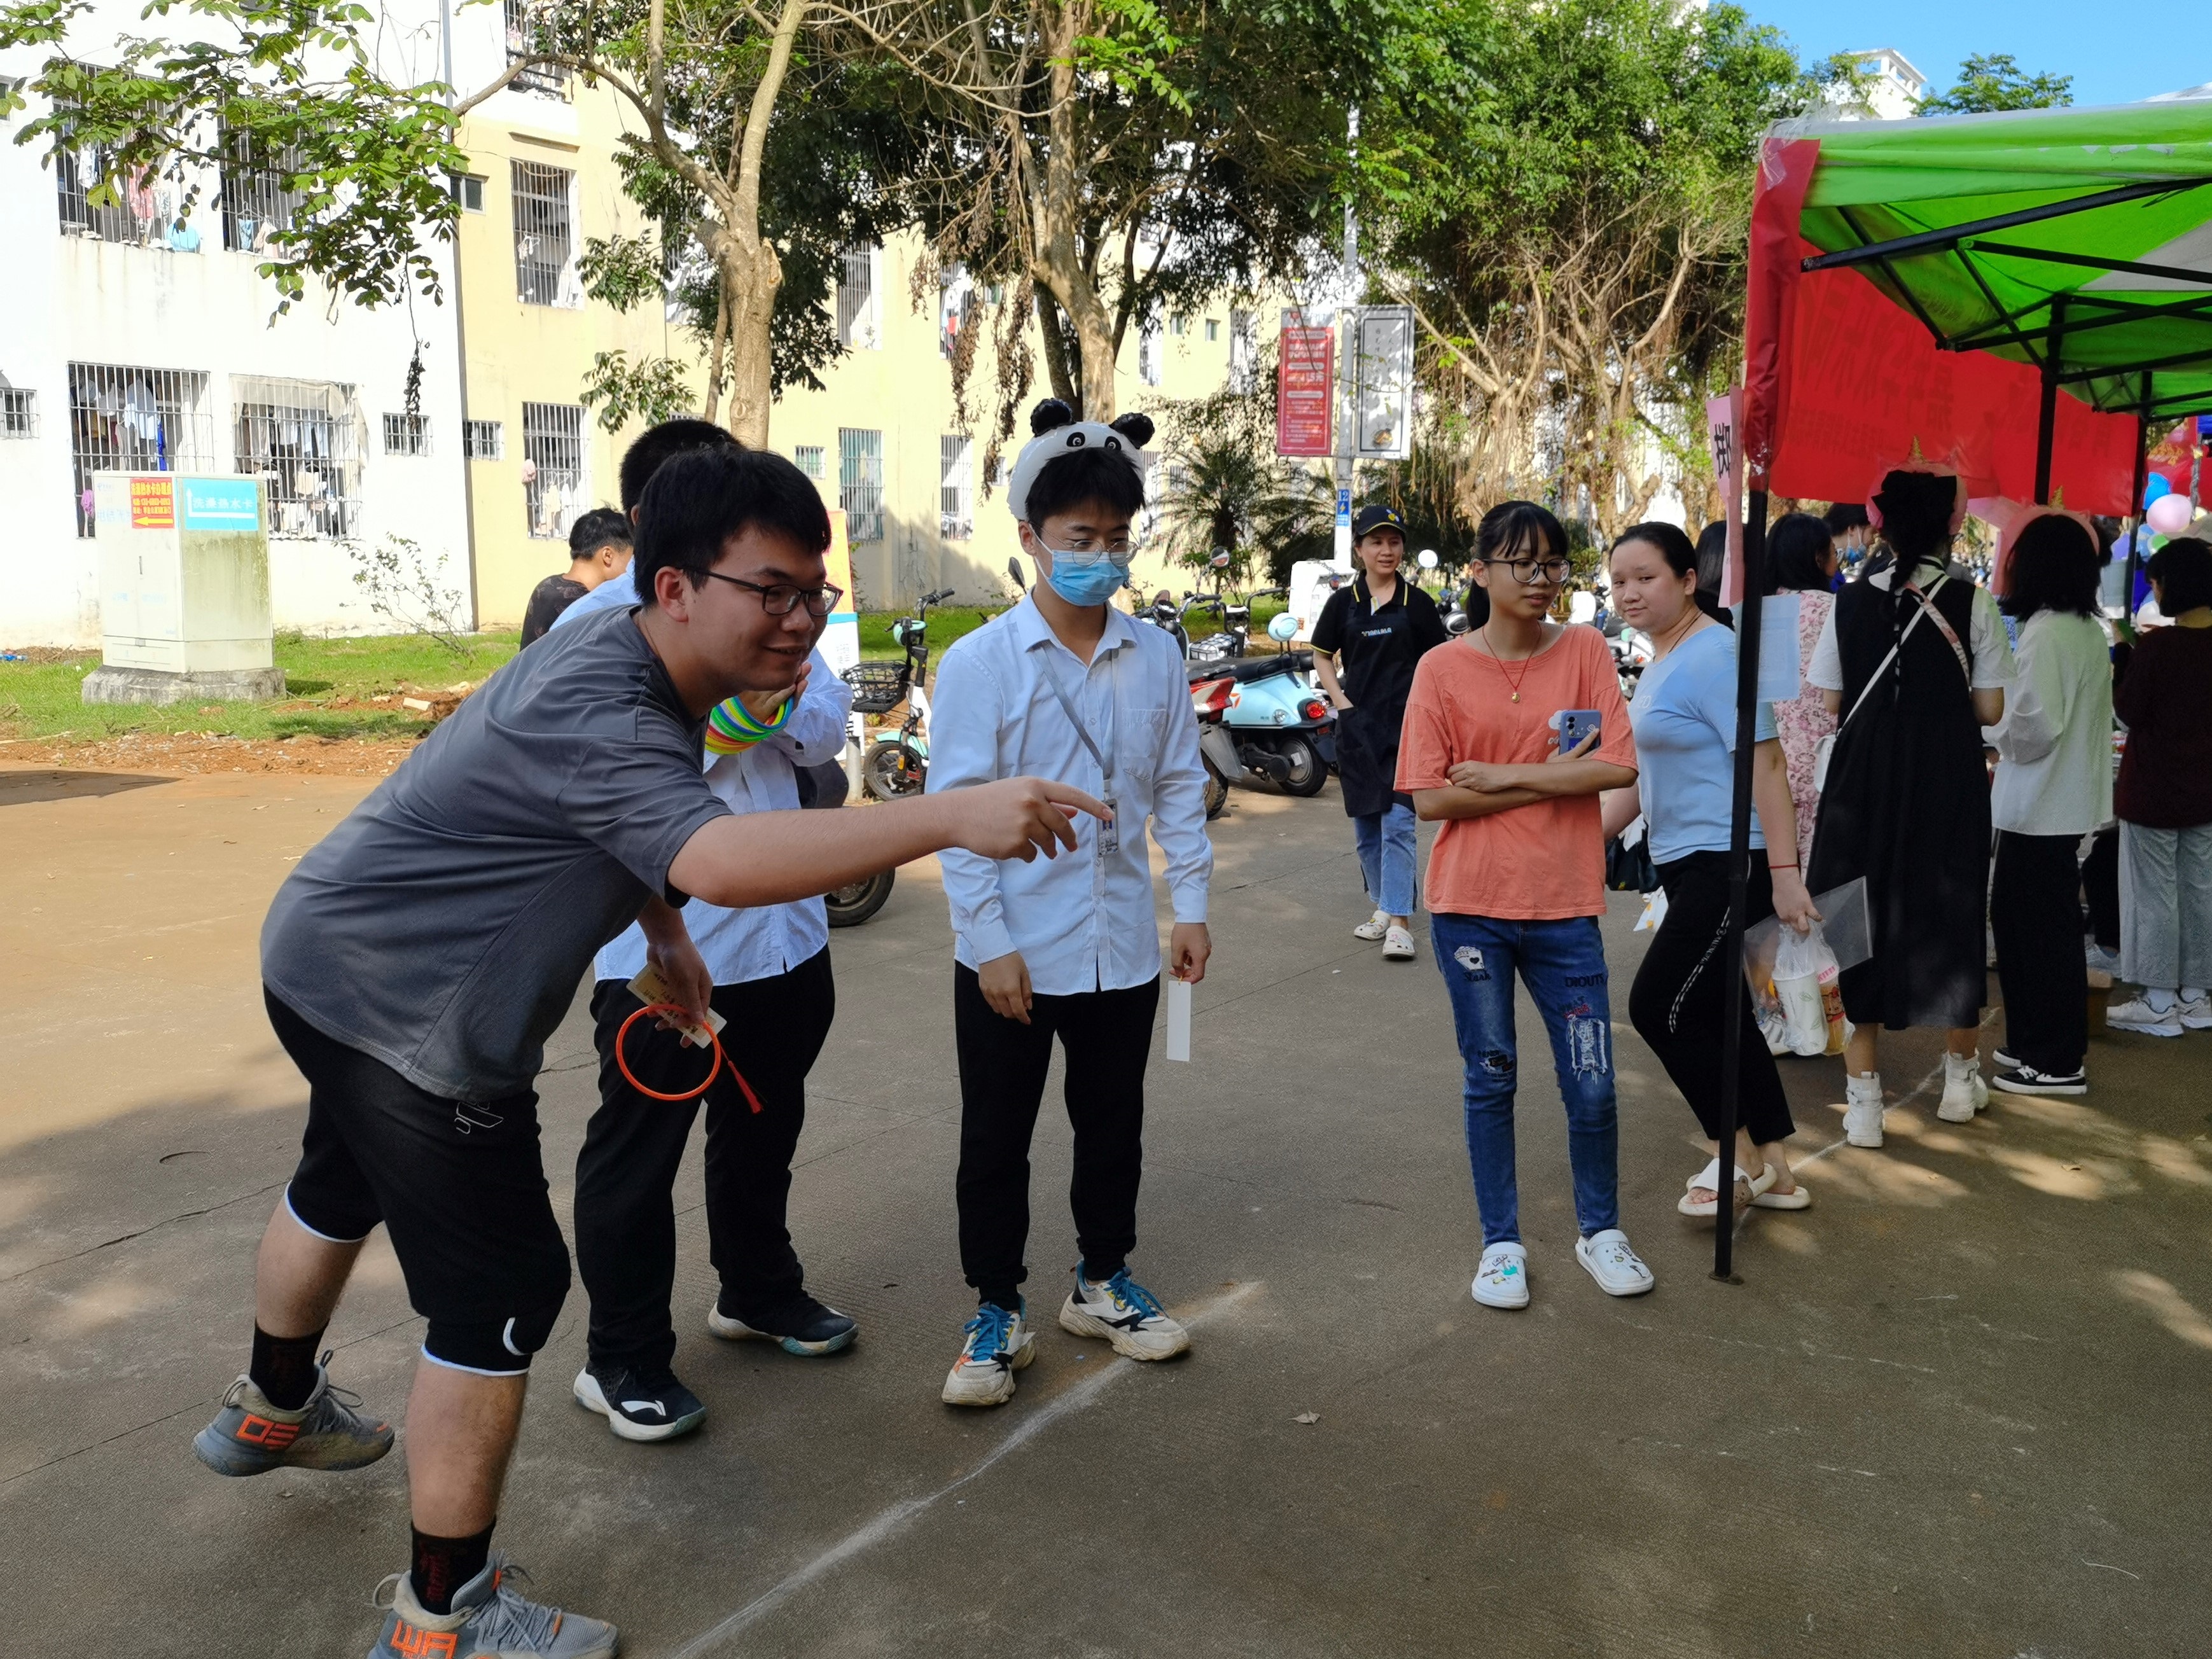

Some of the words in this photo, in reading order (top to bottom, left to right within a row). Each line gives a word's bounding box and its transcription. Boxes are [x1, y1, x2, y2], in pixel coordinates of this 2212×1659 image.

[1339, 490, 1349, 501] 12
[192, 497, 253, 510] 洗澡热水卡
